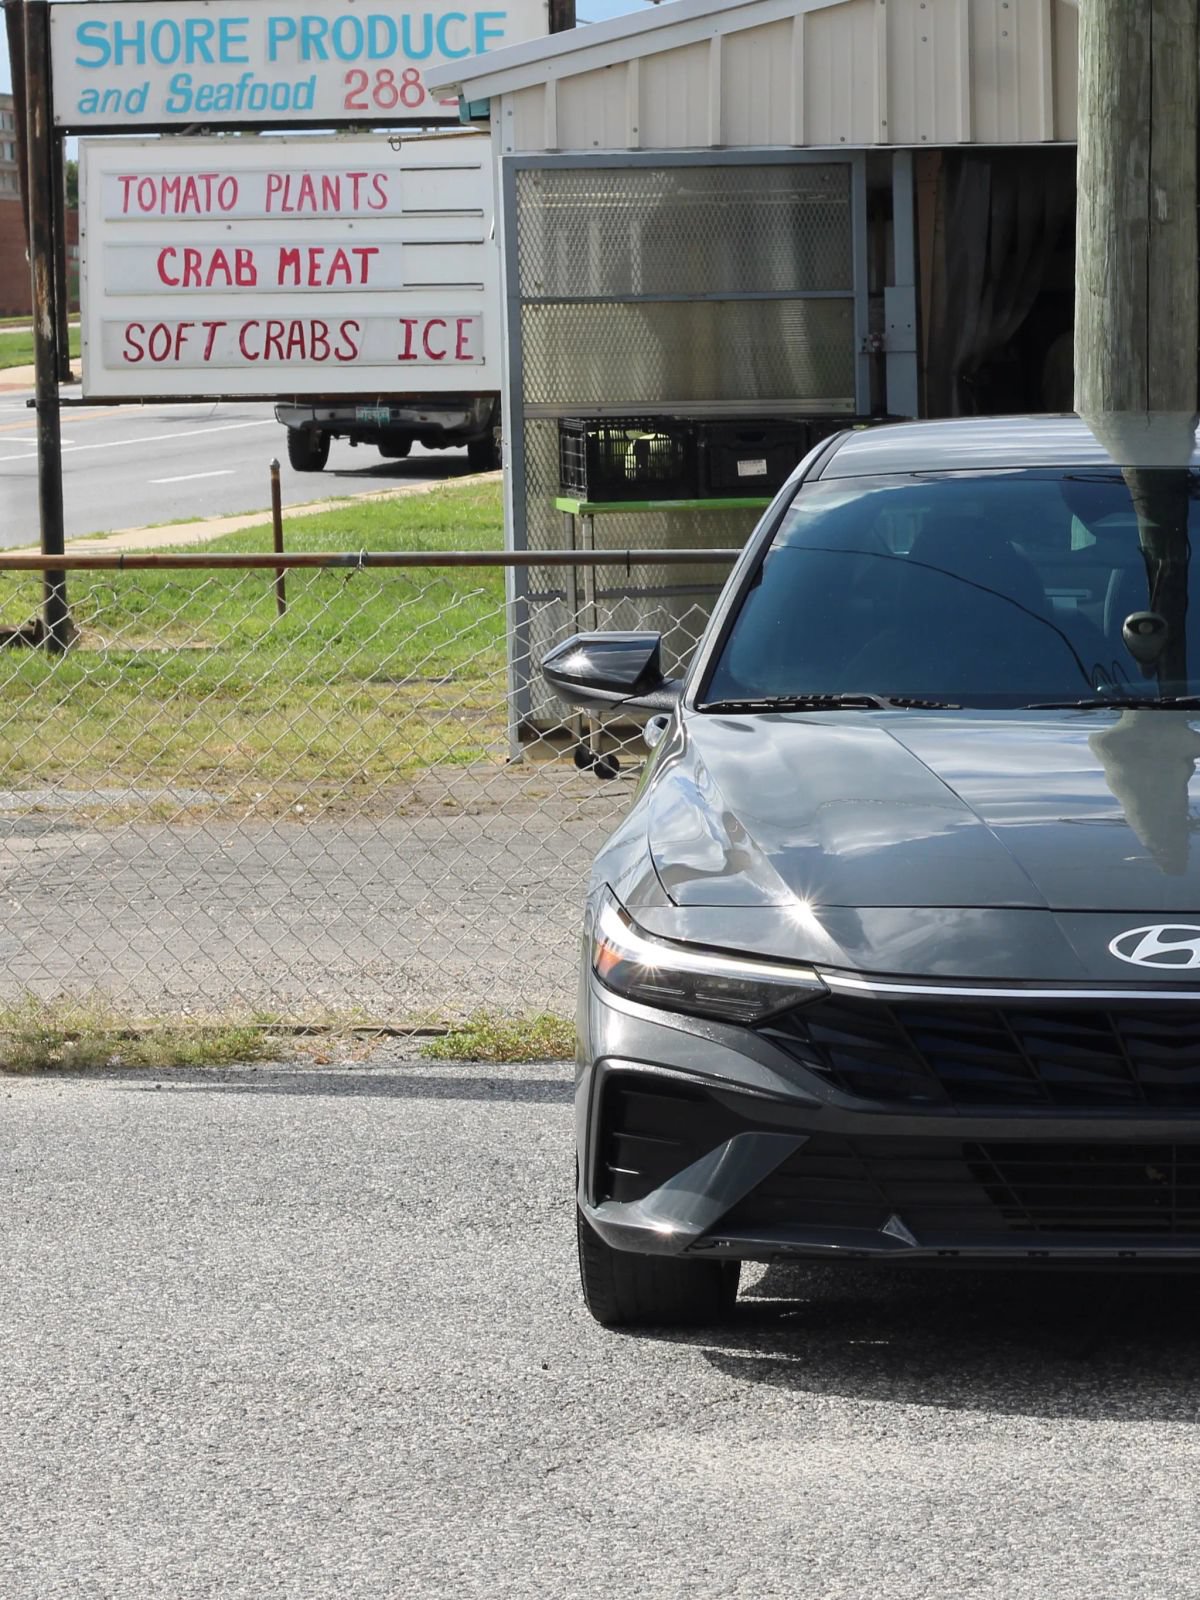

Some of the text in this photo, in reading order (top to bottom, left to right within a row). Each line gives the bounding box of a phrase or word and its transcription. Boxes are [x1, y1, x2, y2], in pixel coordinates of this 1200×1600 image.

[75, 11, 507, 69] SHORE PRODUCE
[77, 81, 150, 115] and
[165, 71, 317, 114] Seafood
[117, 171, 389, 213] TOMATO PLANTS
[156, 246, 379, 288] CRAB MEAT
[122, 318, 474, 363] SOFT CRABS ICE
